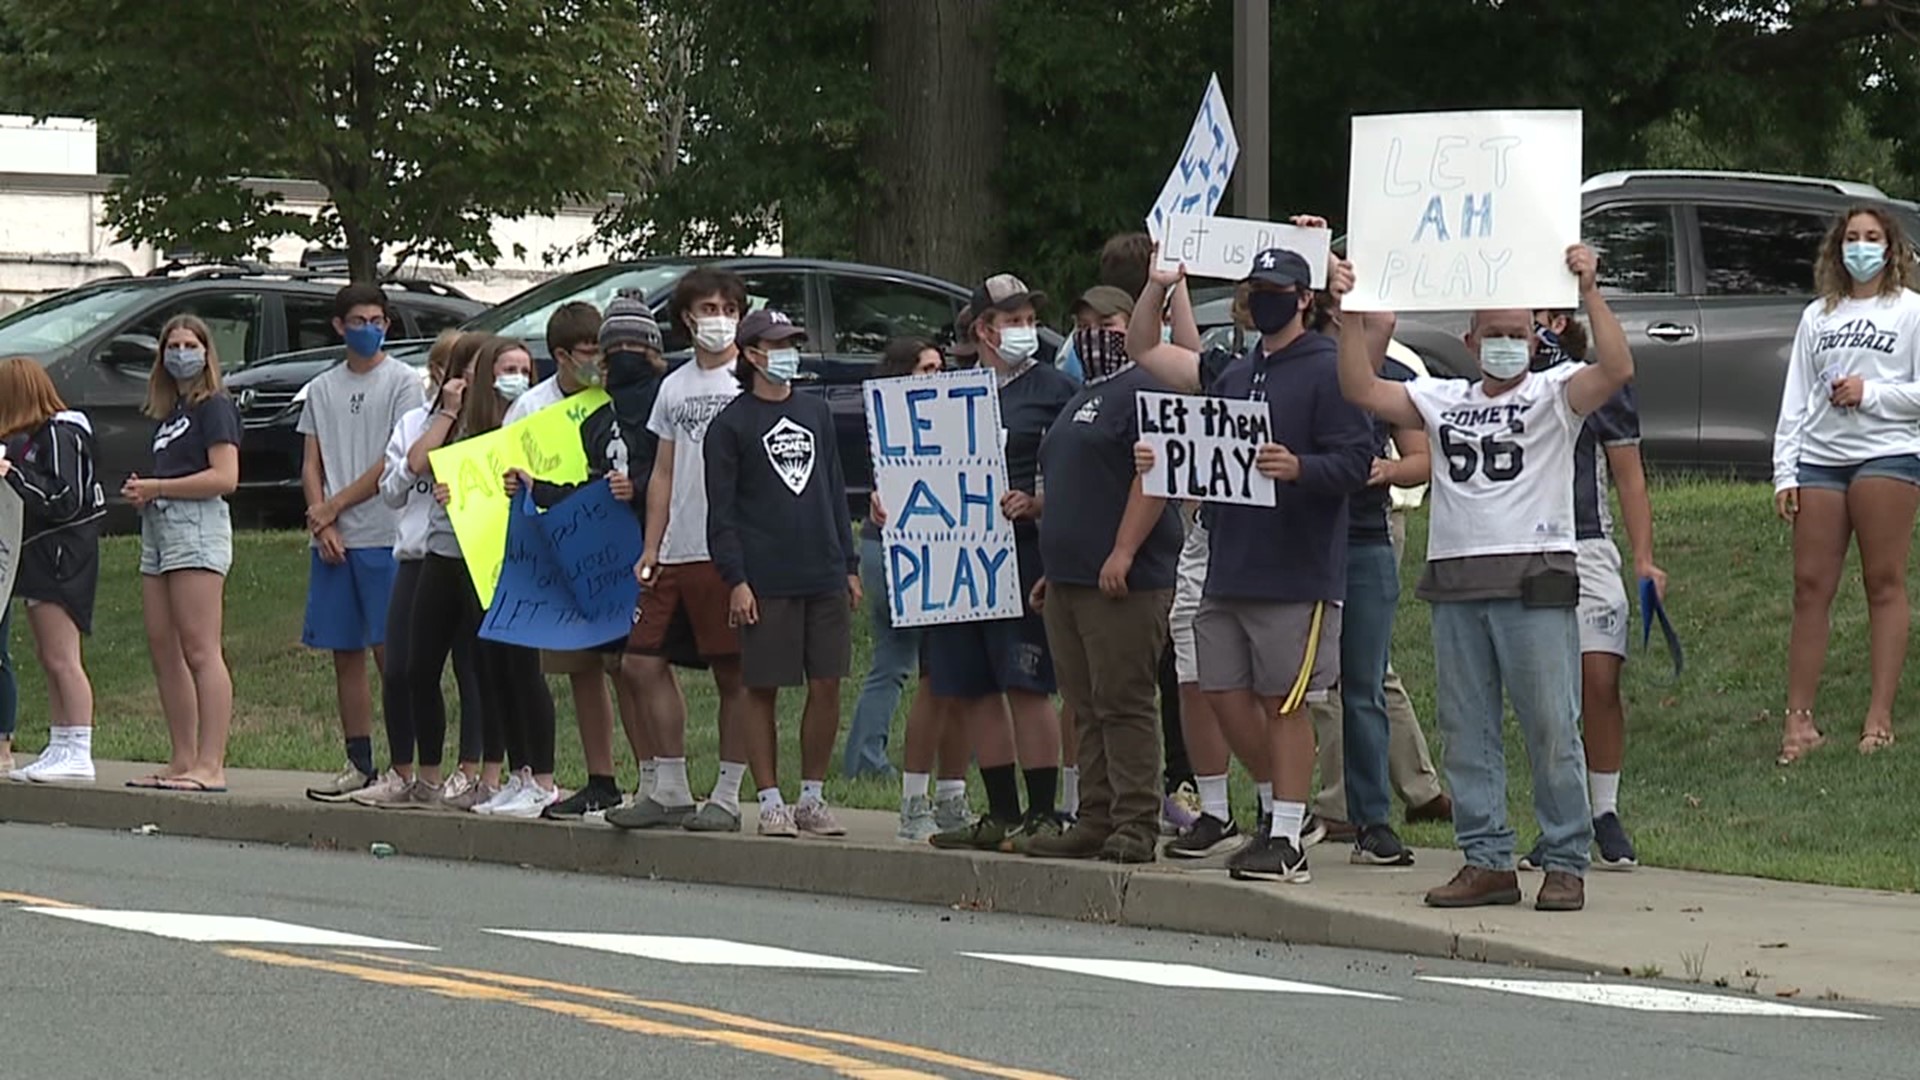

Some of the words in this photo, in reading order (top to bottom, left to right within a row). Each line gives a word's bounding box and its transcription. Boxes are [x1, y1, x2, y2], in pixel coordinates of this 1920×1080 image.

[1383, 136, 1521, 197] LET
[1164, 218, 1209, 263] Let
[1223, 243, 1245, 264] us
[1412, 192, 1493, 242] AH
[1378, 248, 1512, 300] PLAY
[1815, 332, 1896, 354] FOOTBALL
[873, 386, 988, 456] LET
[1166, 439, 1256, 498] PLAY
[896, 472, 993, 531] AH
[890, 544, 1009, 617] PLAY
